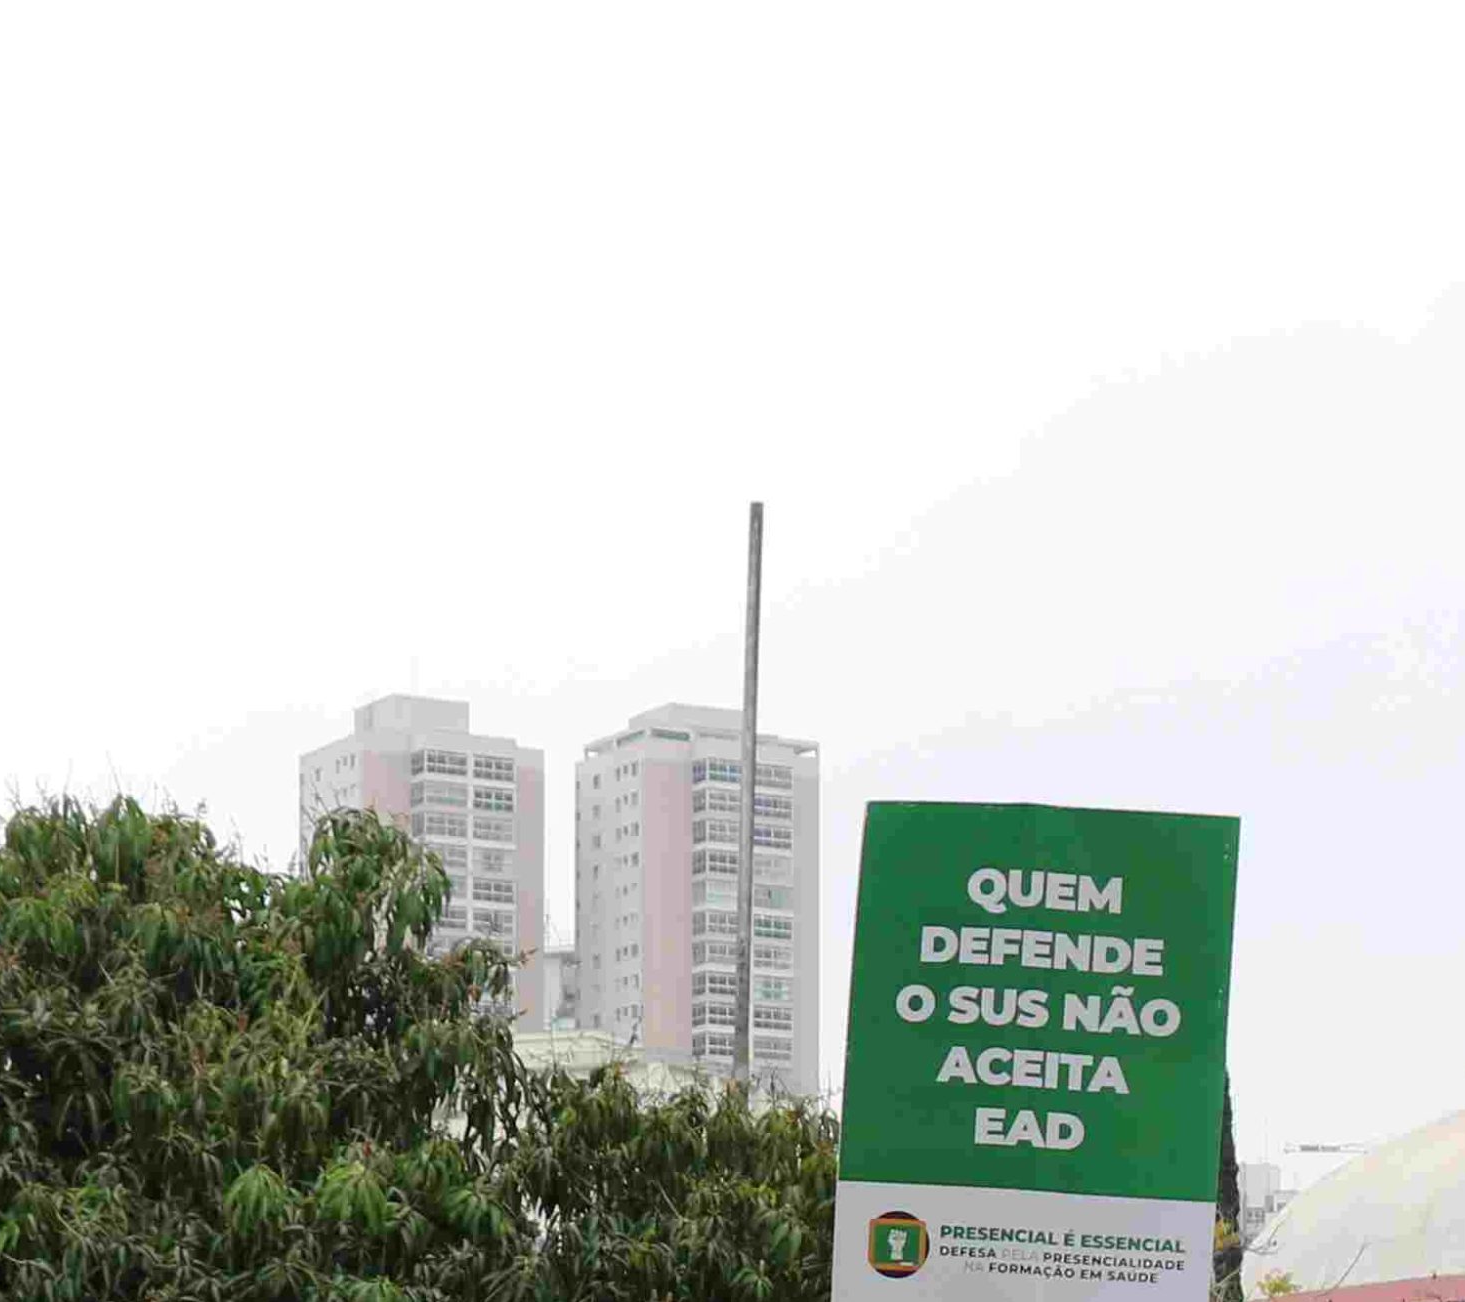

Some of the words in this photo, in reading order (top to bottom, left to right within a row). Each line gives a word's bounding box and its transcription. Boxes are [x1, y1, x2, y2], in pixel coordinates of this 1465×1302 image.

[967, 868, 1123, 915] QUEM
[920, 926, 1165, 977] DEFENDE
[895, 985, 935, 1023] O
[948, 988, 1049, 1027] SUS
[1063, 987, 1181, 1037] NÃO
[937, 1047, 1130, 1094] ACEITA
[974, 1108, 1085, 1151] EAD
[940, 1225, 1057, 1246] PRESENCIAL
[1064, 1229, 1075, 1246] É
[1081, 1234, 1186, 1253] ESSENCIAL
[940, 1246, 997, 1258] DEFESA
[1043, 1253, 1185, 1270] PRESENCIALIDADE
[989, 1262, 1075, 1279] FORMAÇÃO
[1081, 1269, 1101, 1280] EM
